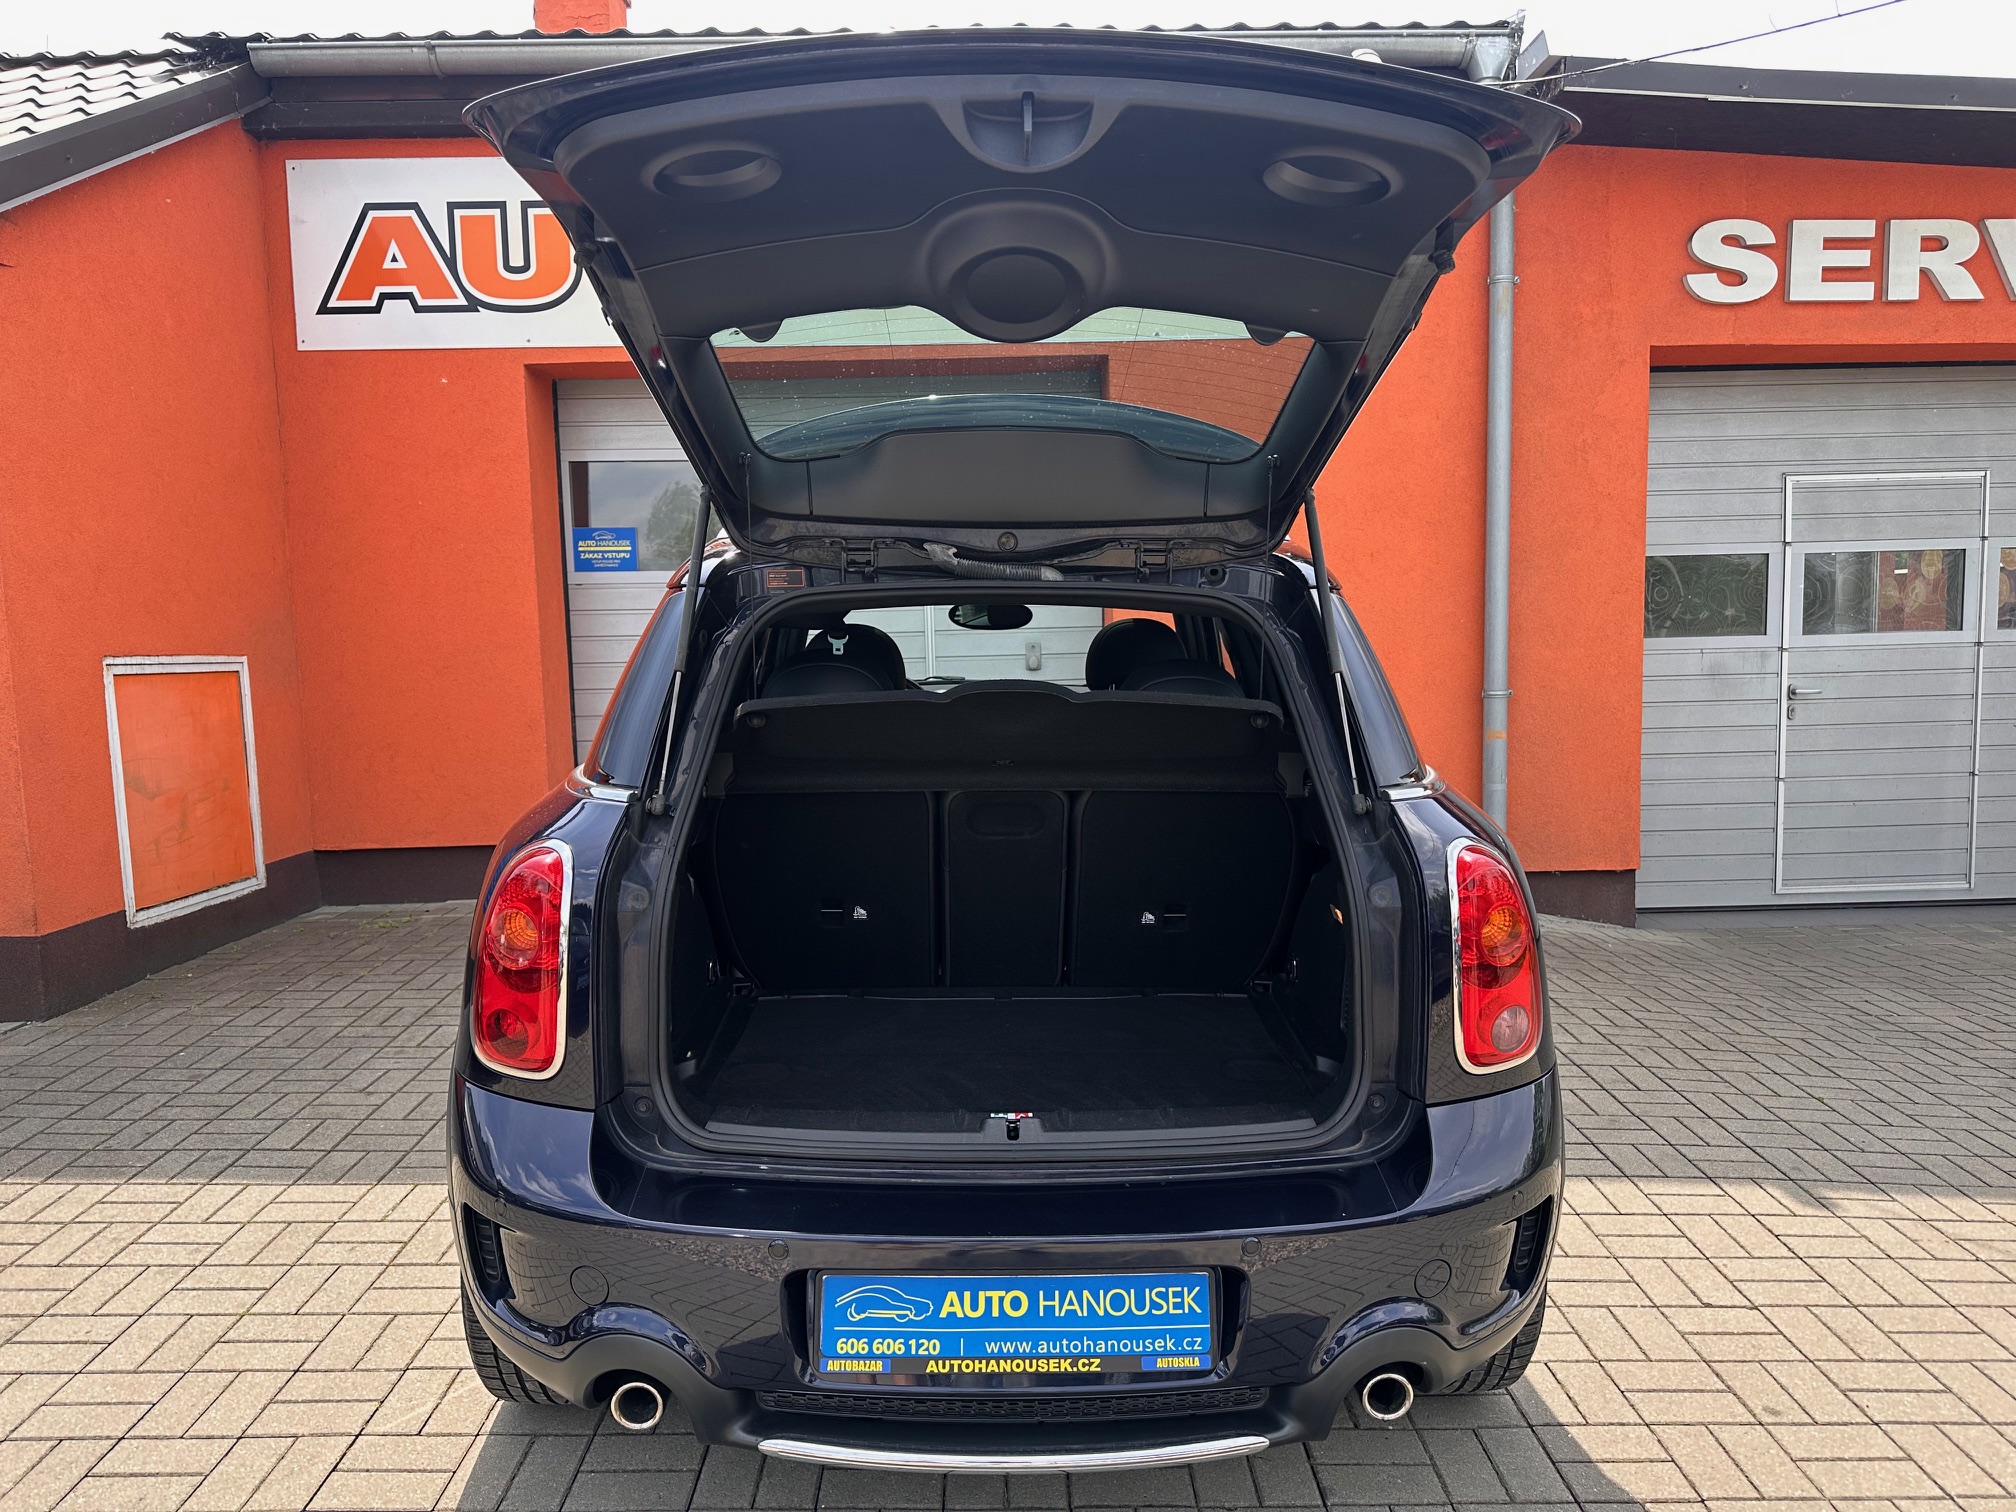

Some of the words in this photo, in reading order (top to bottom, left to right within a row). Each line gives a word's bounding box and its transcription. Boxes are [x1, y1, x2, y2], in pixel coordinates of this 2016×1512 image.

[939, 1290, 1029, 1318] AUTO
[1038, 1286, 1202, 1317] HANOUSEK
[836, 1337, 869, 1355] 606
[872, 1337, 905, 1355] 606
[908, 1338, 940, 1355] 120
[985, 1334, 1203, 1354] www.autohanousek.cz
[827, 1360, 883, 1372] AUTOBAZAR
[925, 1358, 1101, 1374] AUTOHANOUSEK.CZ
[1156, 1357, 1200, 1368] AUTOSKLA
